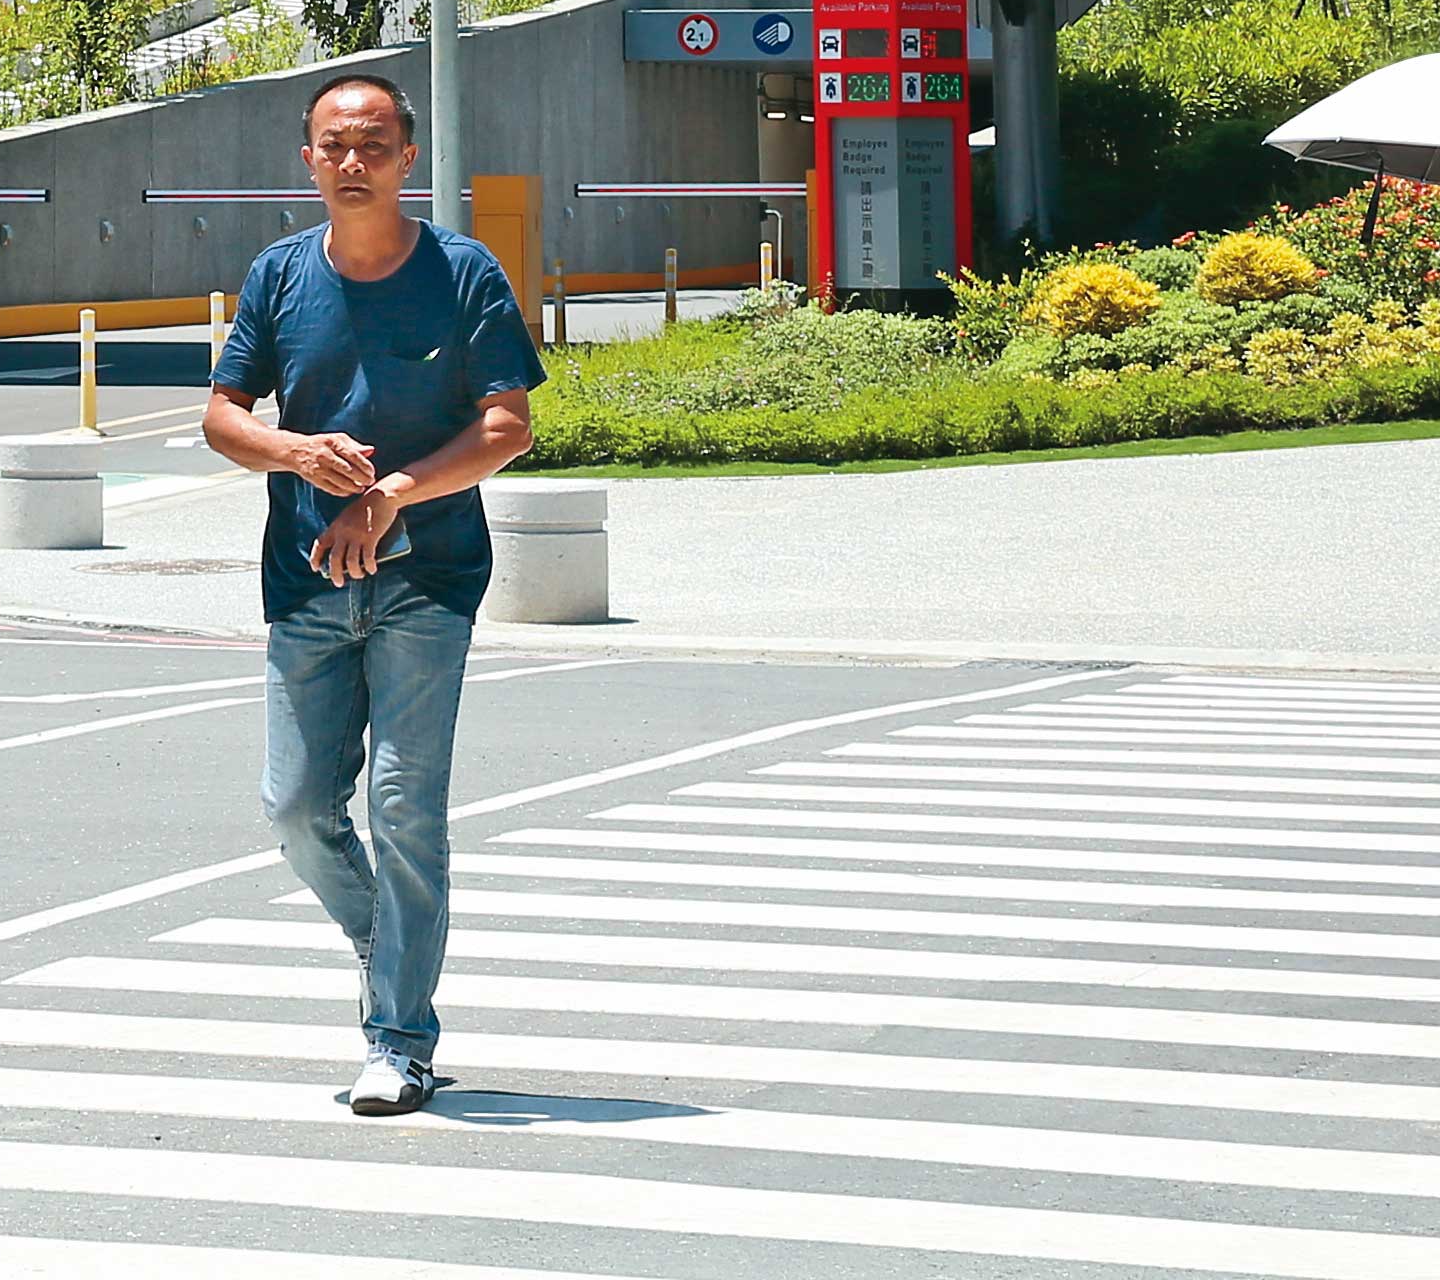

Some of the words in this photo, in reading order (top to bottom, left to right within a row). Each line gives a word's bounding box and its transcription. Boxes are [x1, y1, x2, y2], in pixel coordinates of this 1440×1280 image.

[847, 75, 889, 101] 264
[924, 74, 960, 100] 264
[842, 139, 888, 150] Employee
[842, 152, 872, 163] Badge
[843, 165, 886, 176] Required
